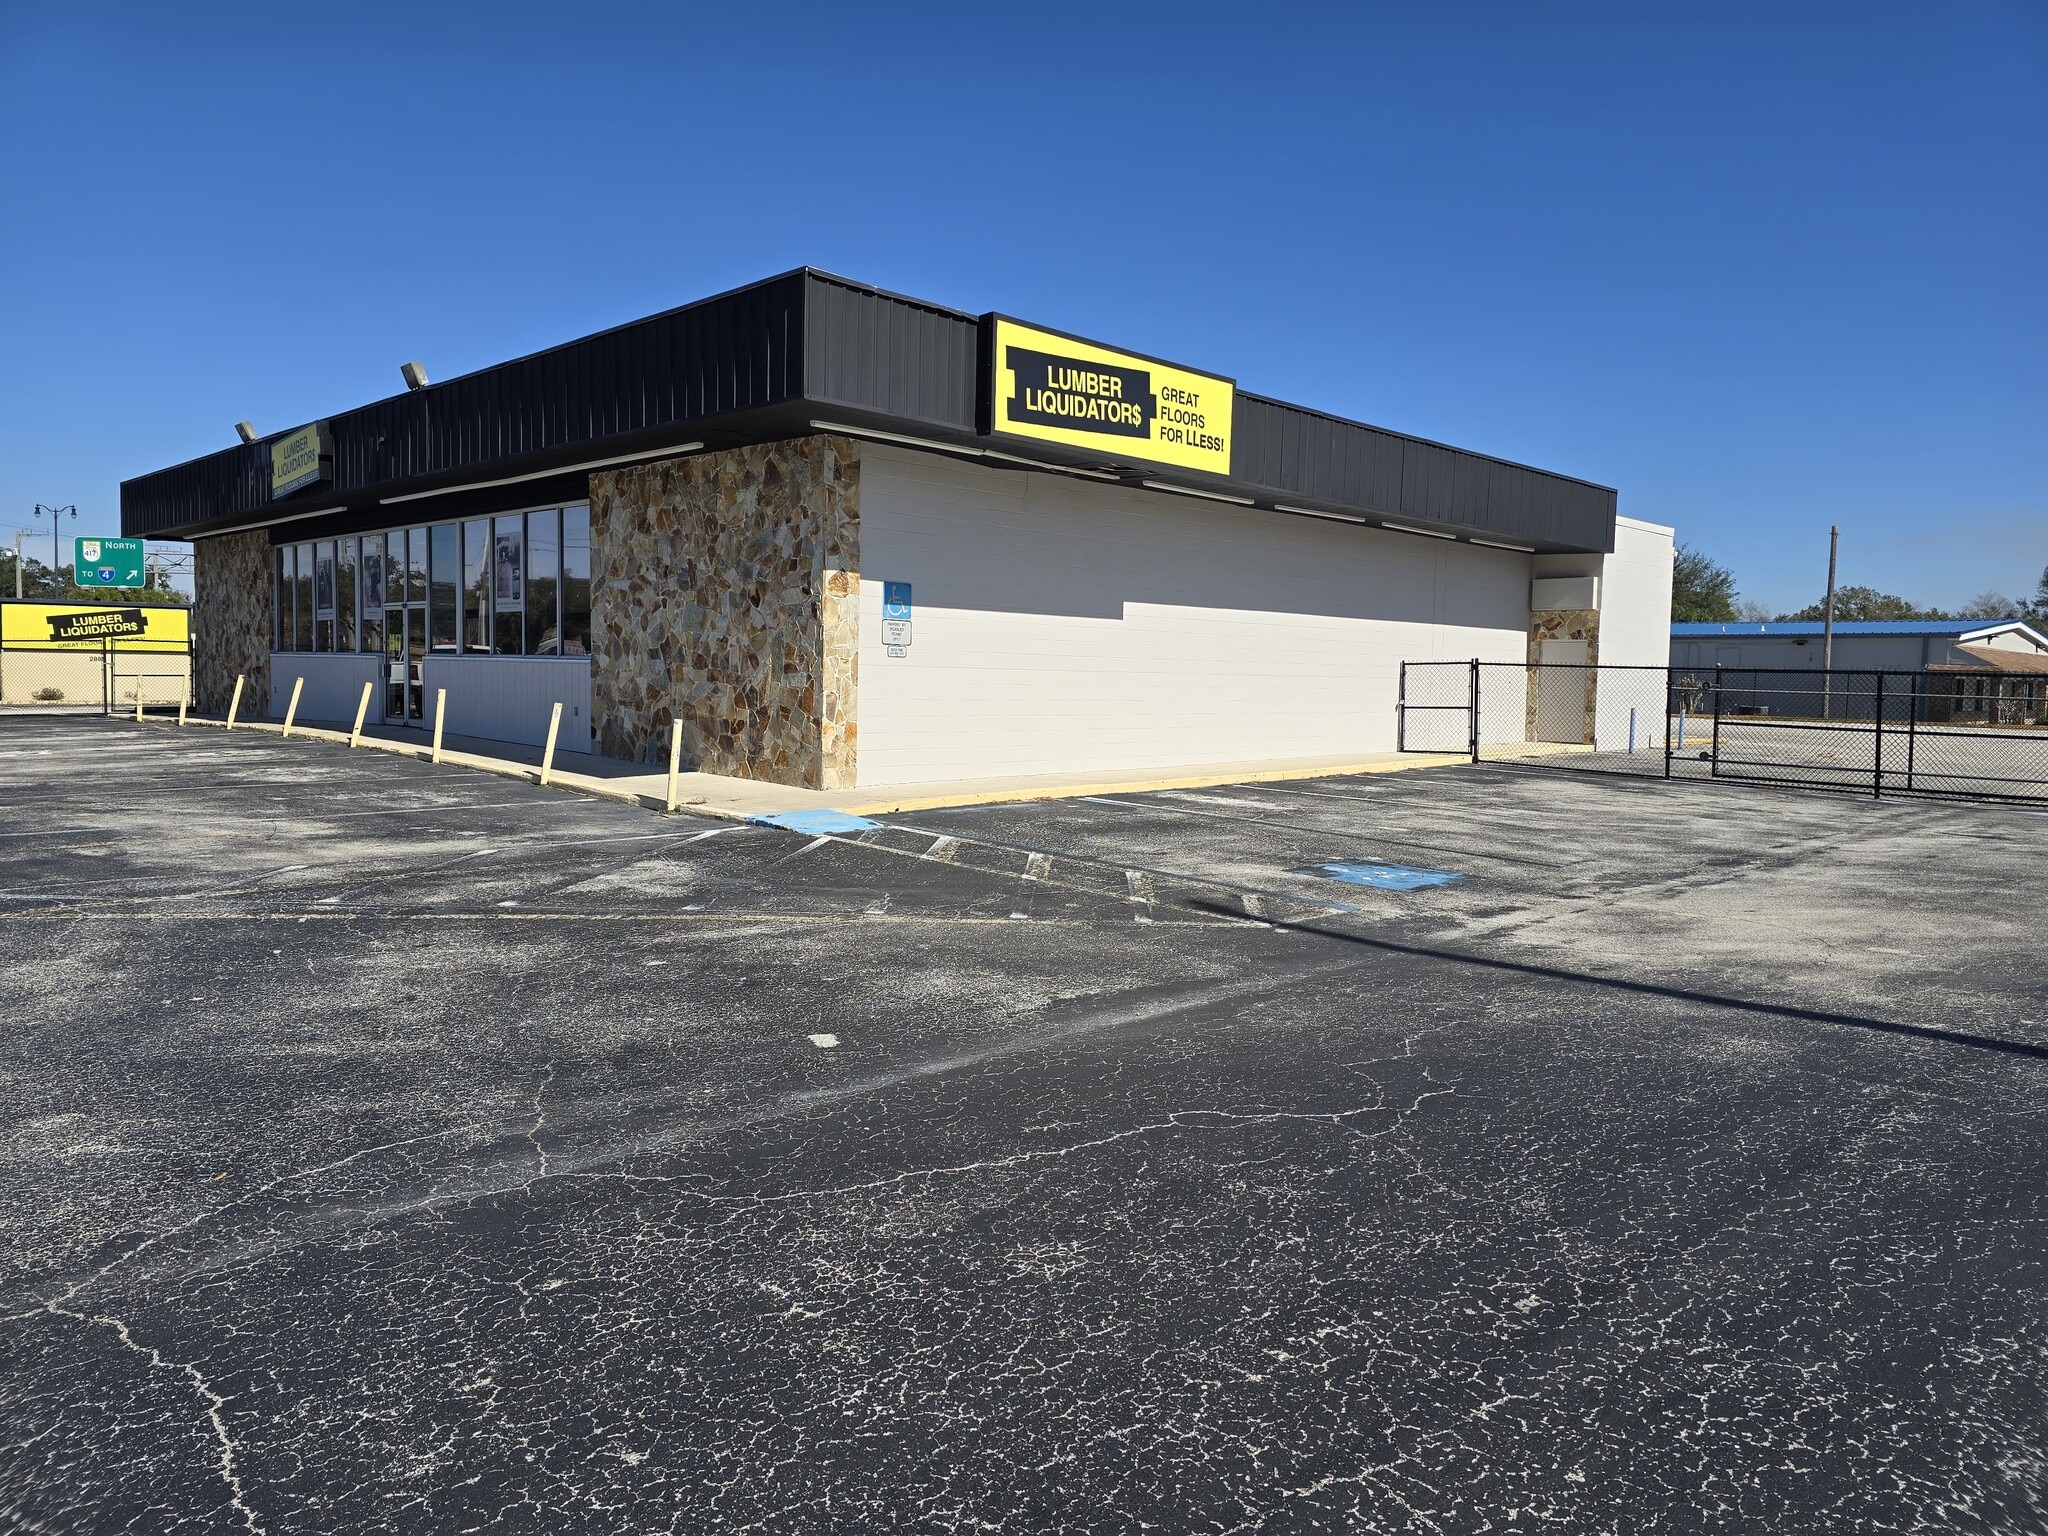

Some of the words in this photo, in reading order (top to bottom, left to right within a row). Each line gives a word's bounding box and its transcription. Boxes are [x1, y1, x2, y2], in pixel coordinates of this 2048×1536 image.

[1047, 365, 1122, 398] LUMBER
[1025, 387, 1142, 428] LIQUIDATOR$
[1161, 386, 1199, 408] GREAT
[1161, 406, 1205, 429] FLOORS
[283, 436, 308, 459] LUMBER
[1160, 426, 1183, 444] FOR
[1186, 427, 1224, 452] LLESS!
[102, 570, 110, 580] 4
[60, 621, 138, 637] LIQUIDATOR$
[72, 614, 123, 627] LUMBER
